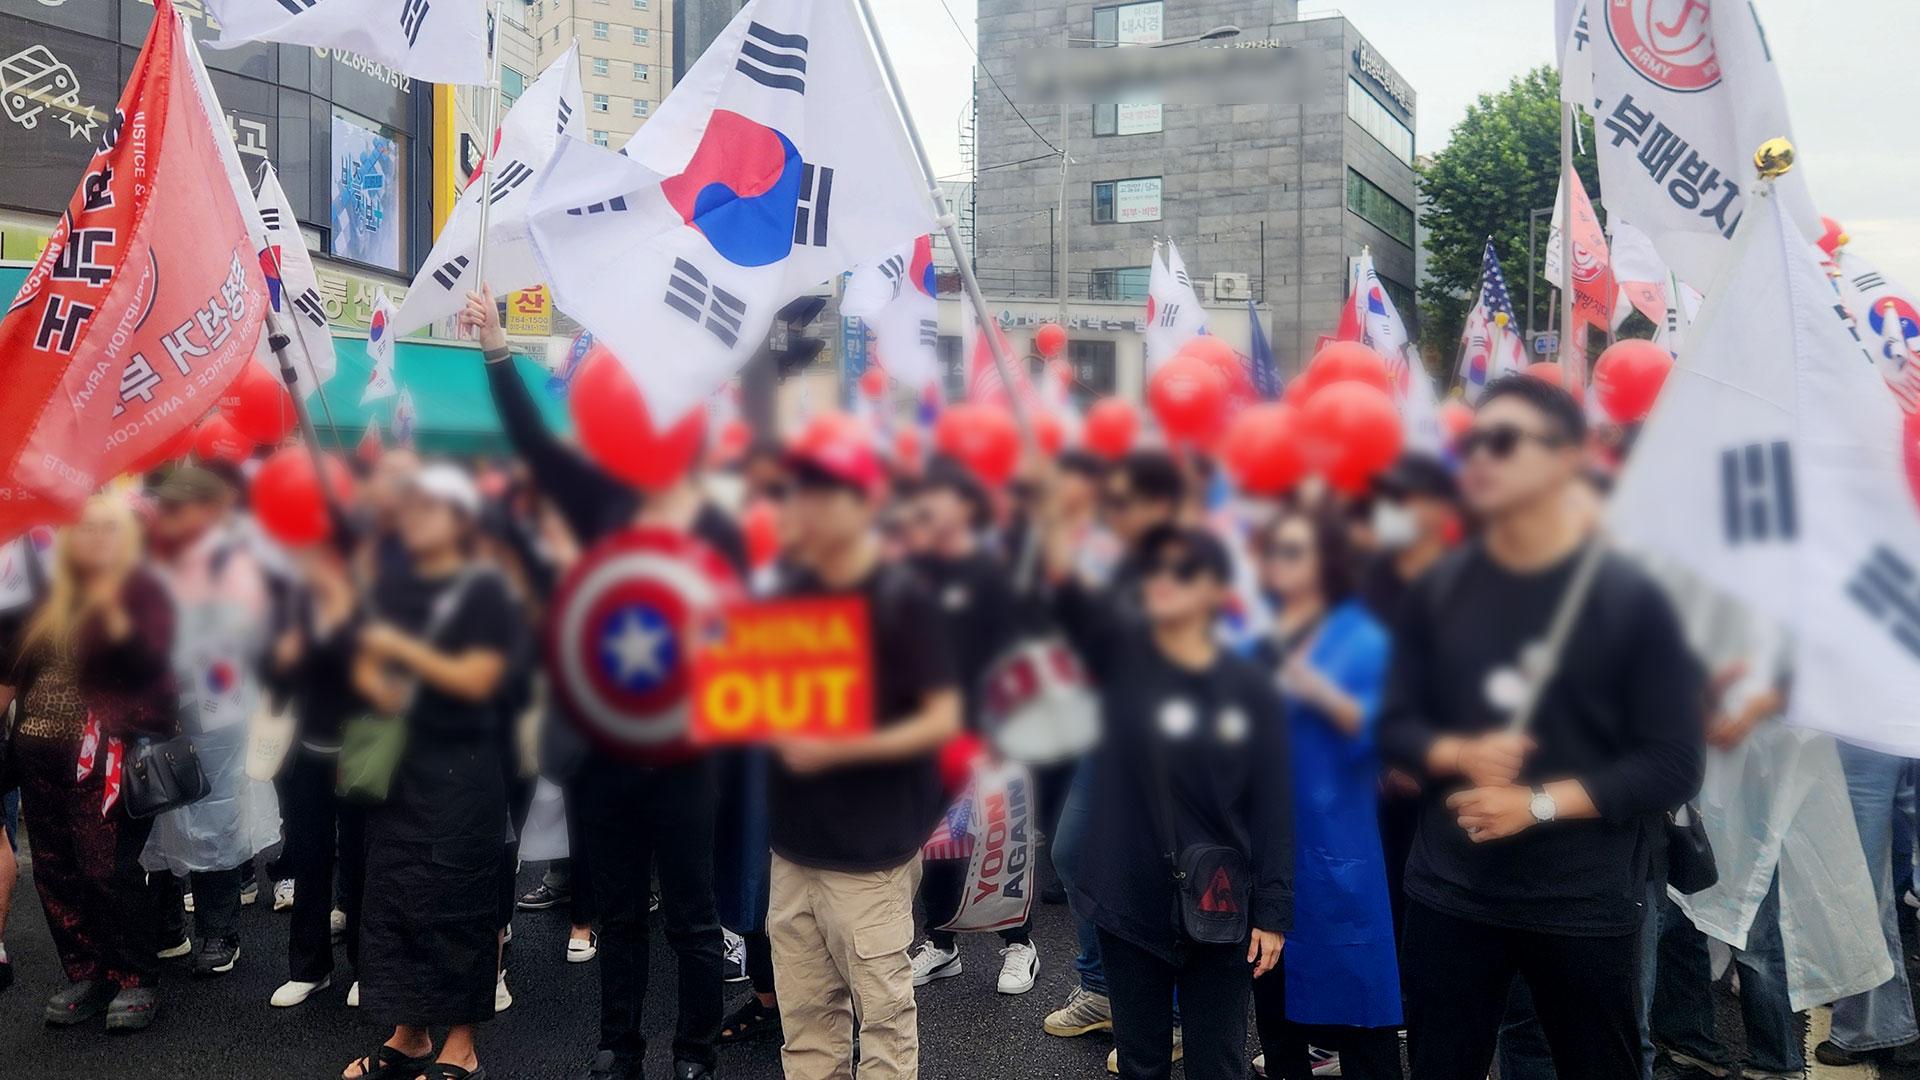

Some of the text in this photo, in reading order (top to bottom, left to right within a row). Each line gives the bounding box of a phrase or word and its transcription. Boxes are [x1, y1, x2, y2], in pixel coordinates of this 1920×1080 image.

[1121, 16, 1159, 33] 내시경
[333, 46, 411, 94] 02.6954.7512
[1630, 44, 1673, 79] ARMY
[704, 669, 858, 732] OUT
[972, 792, 1007, 906] YOON
[1002, 776, 1028, 898] AGAIN
